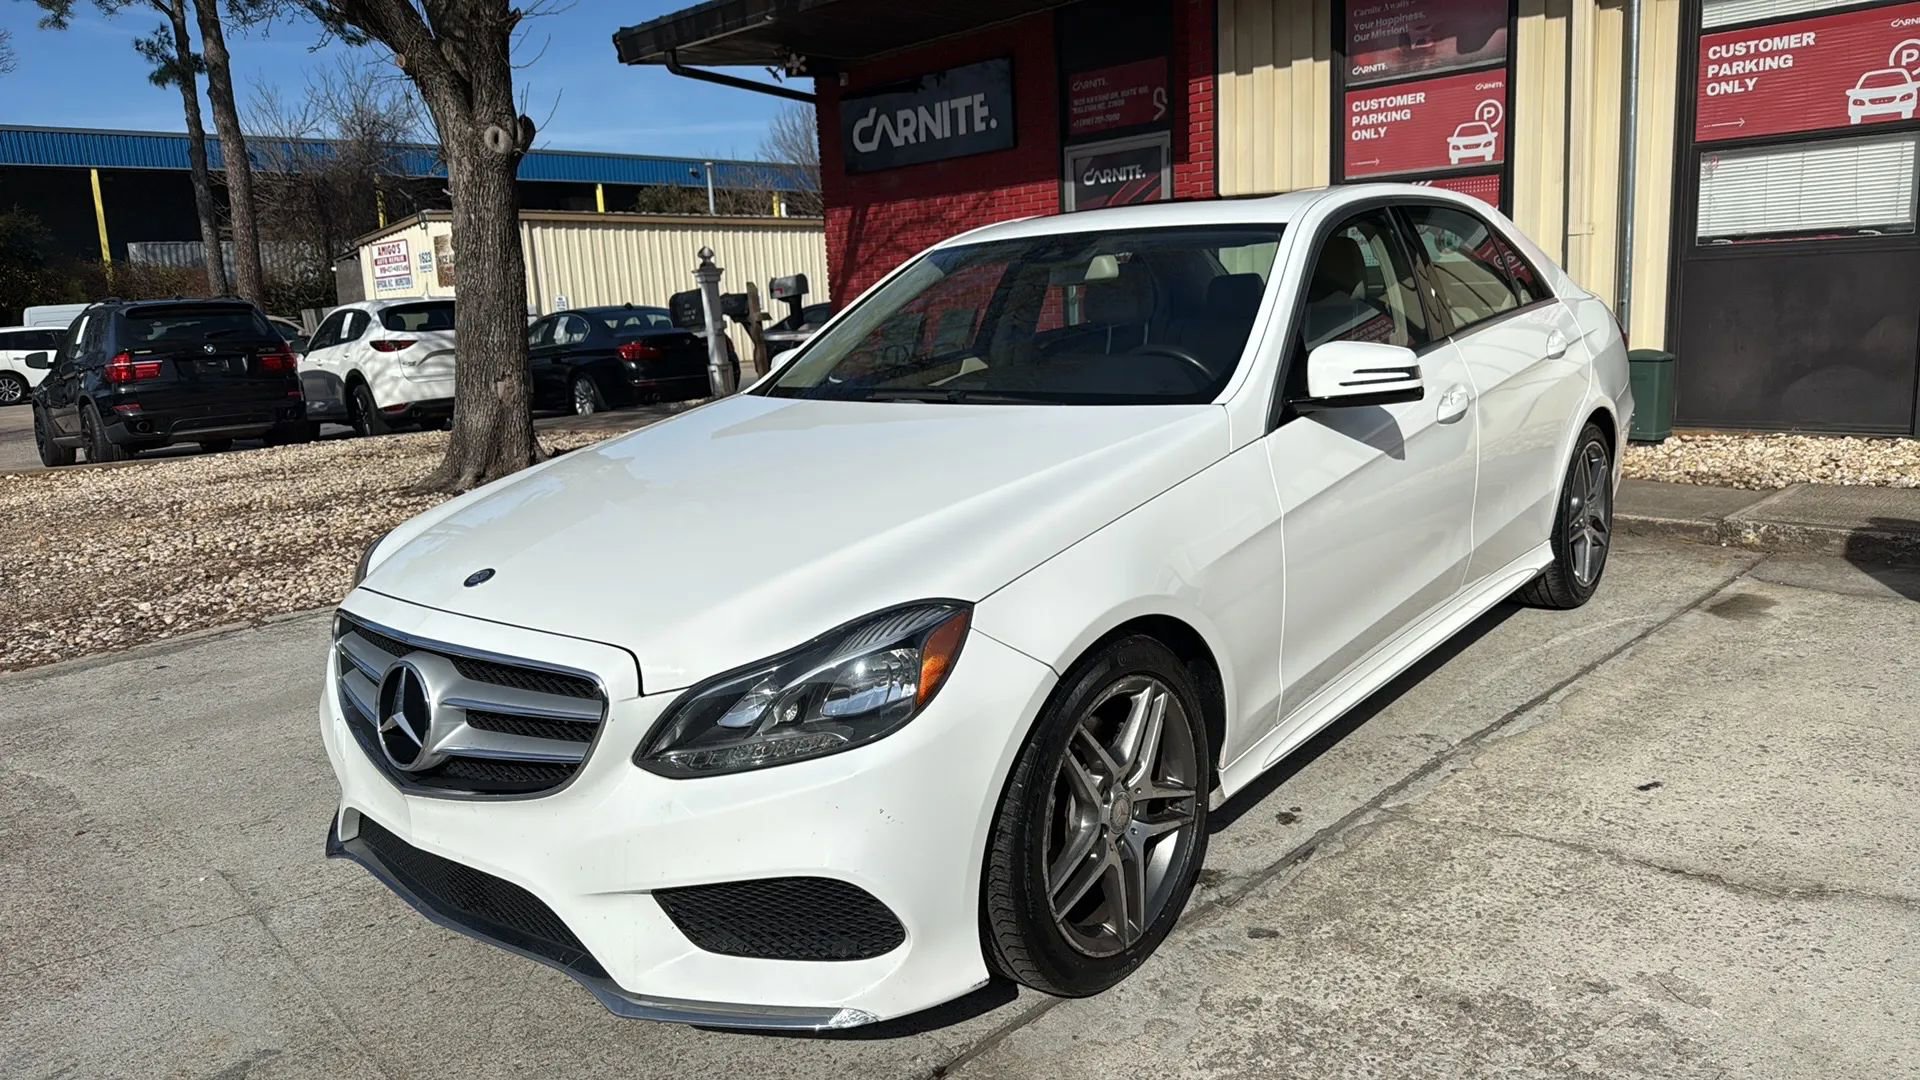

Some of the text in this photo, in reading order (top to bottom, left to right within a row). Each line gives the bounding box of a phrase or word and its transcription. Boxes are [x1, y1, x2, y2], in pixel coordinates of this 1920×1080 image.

[1353, 21, 1374, 31] Your
[1353, 32, 1370, 42] Our
[1707, 32, 1816, 60] CUSTOMER
[1707, 54, 1793, 78] PARKING
[1706, 77, 1758, 97] ONLY
[1352, 92, 1426, 112] CUSTOMER
[1352, 109, 1411, 127] PARKING
[1352, 126, 1387, 141] ONLY
